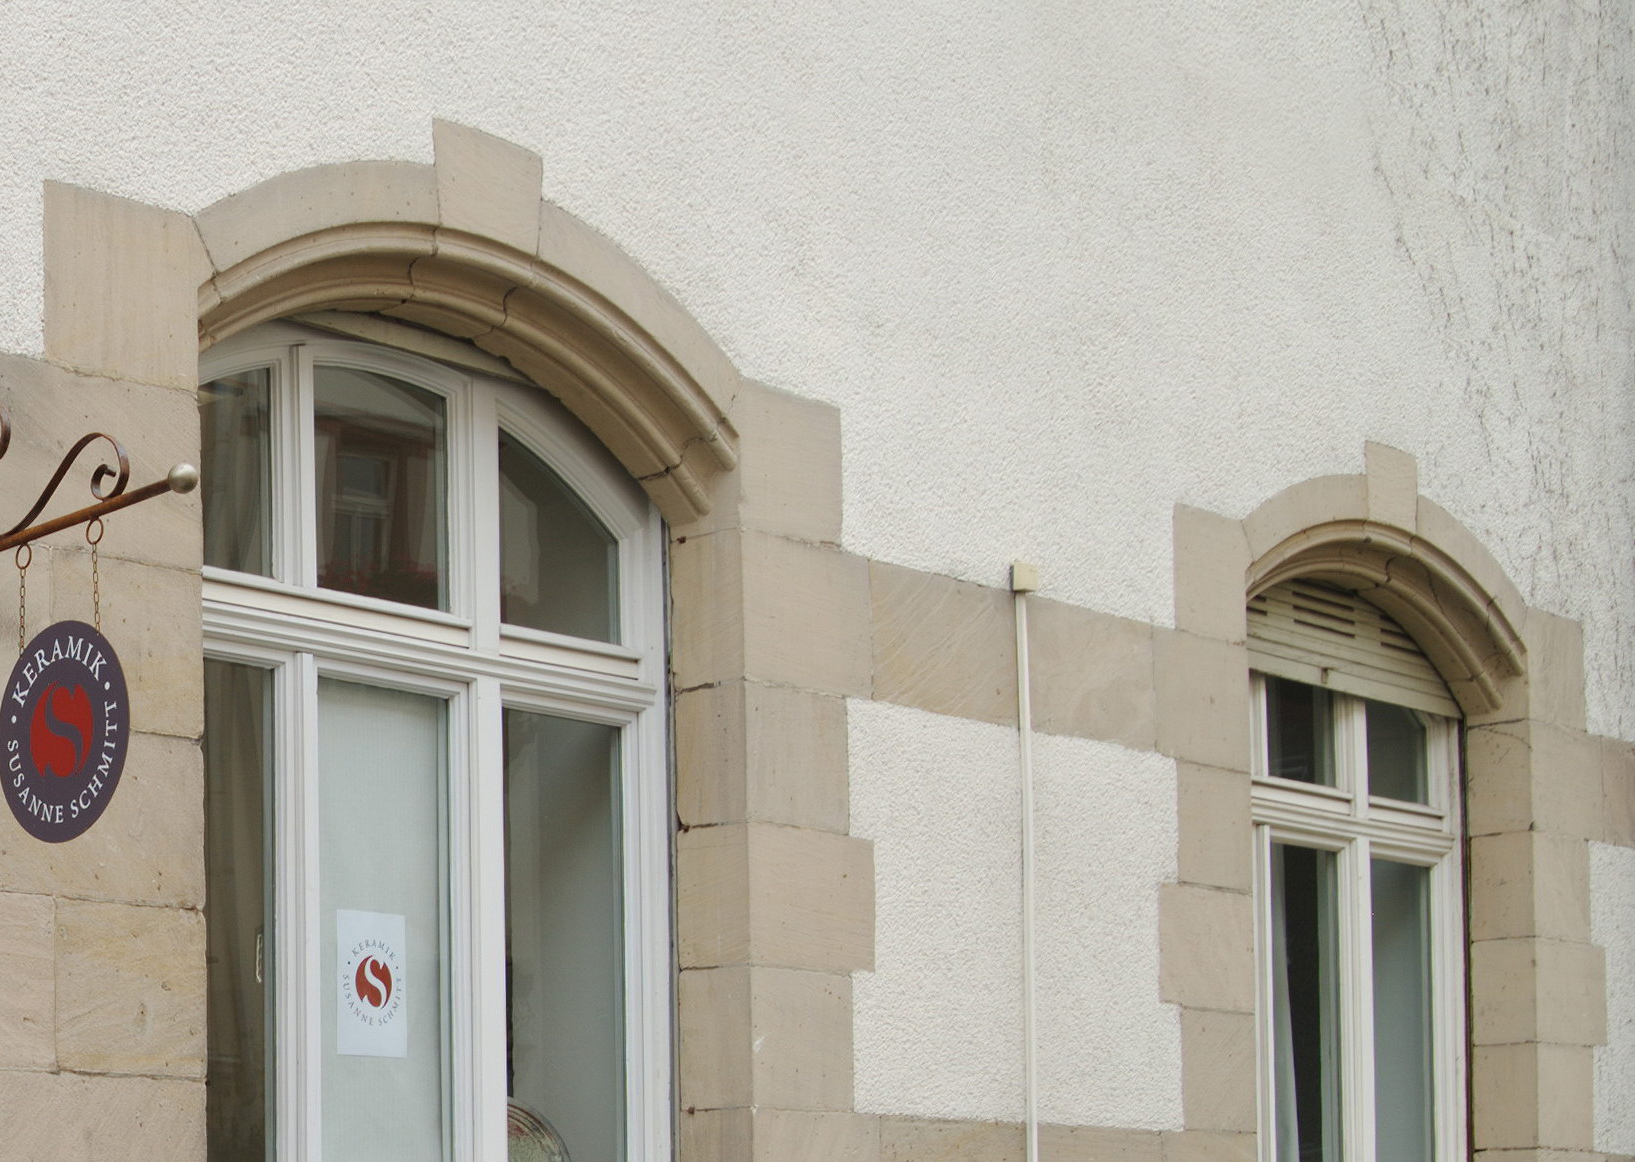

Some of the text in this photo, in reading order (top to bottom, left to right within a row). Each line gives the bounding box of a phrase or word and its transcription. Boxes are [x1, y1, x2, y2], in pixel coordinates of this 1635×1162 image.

[12, 635, 107, 707] KERAMIK
[7, 701, 117, 824] SUSANNE SCHMITT
[352, 939, 396, 961] KERAMIK
[343, 974, 402, 1026] SUSANNE SCHMITT
